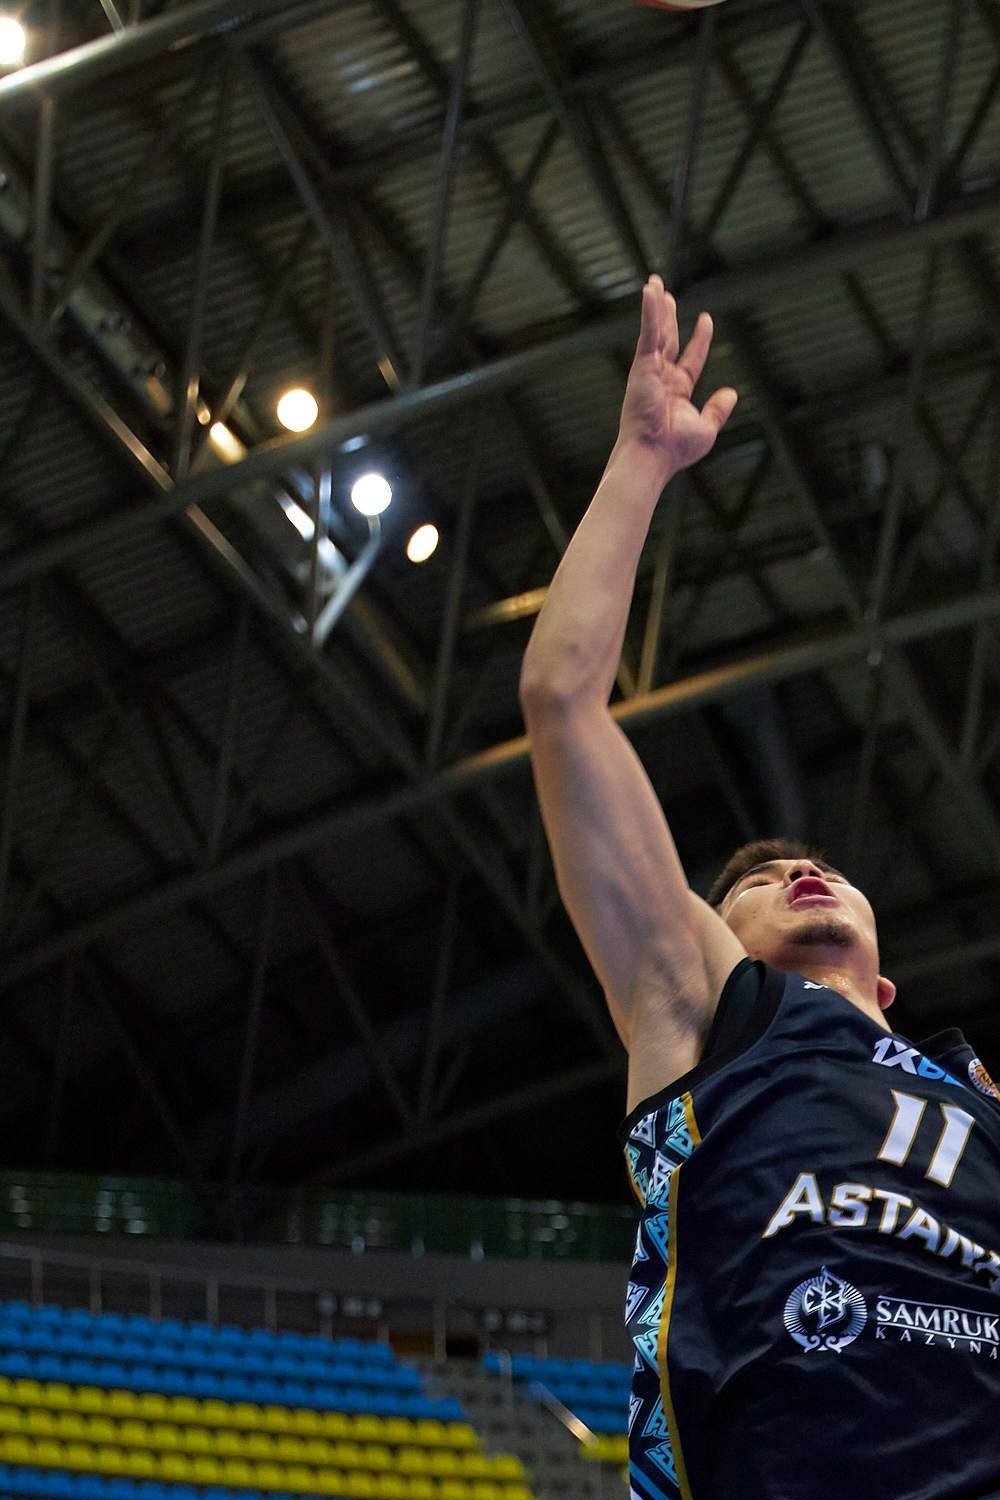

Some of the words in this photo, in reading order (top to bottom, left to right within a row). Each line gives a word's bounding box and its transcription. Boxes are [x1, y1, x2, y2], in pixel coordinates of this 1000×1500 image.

[877, 1087, 977, 1189] 11
[875, 1300, 1000, 1342] SAMRUK
[875, 1325, 999, 1361] KAZYNA
